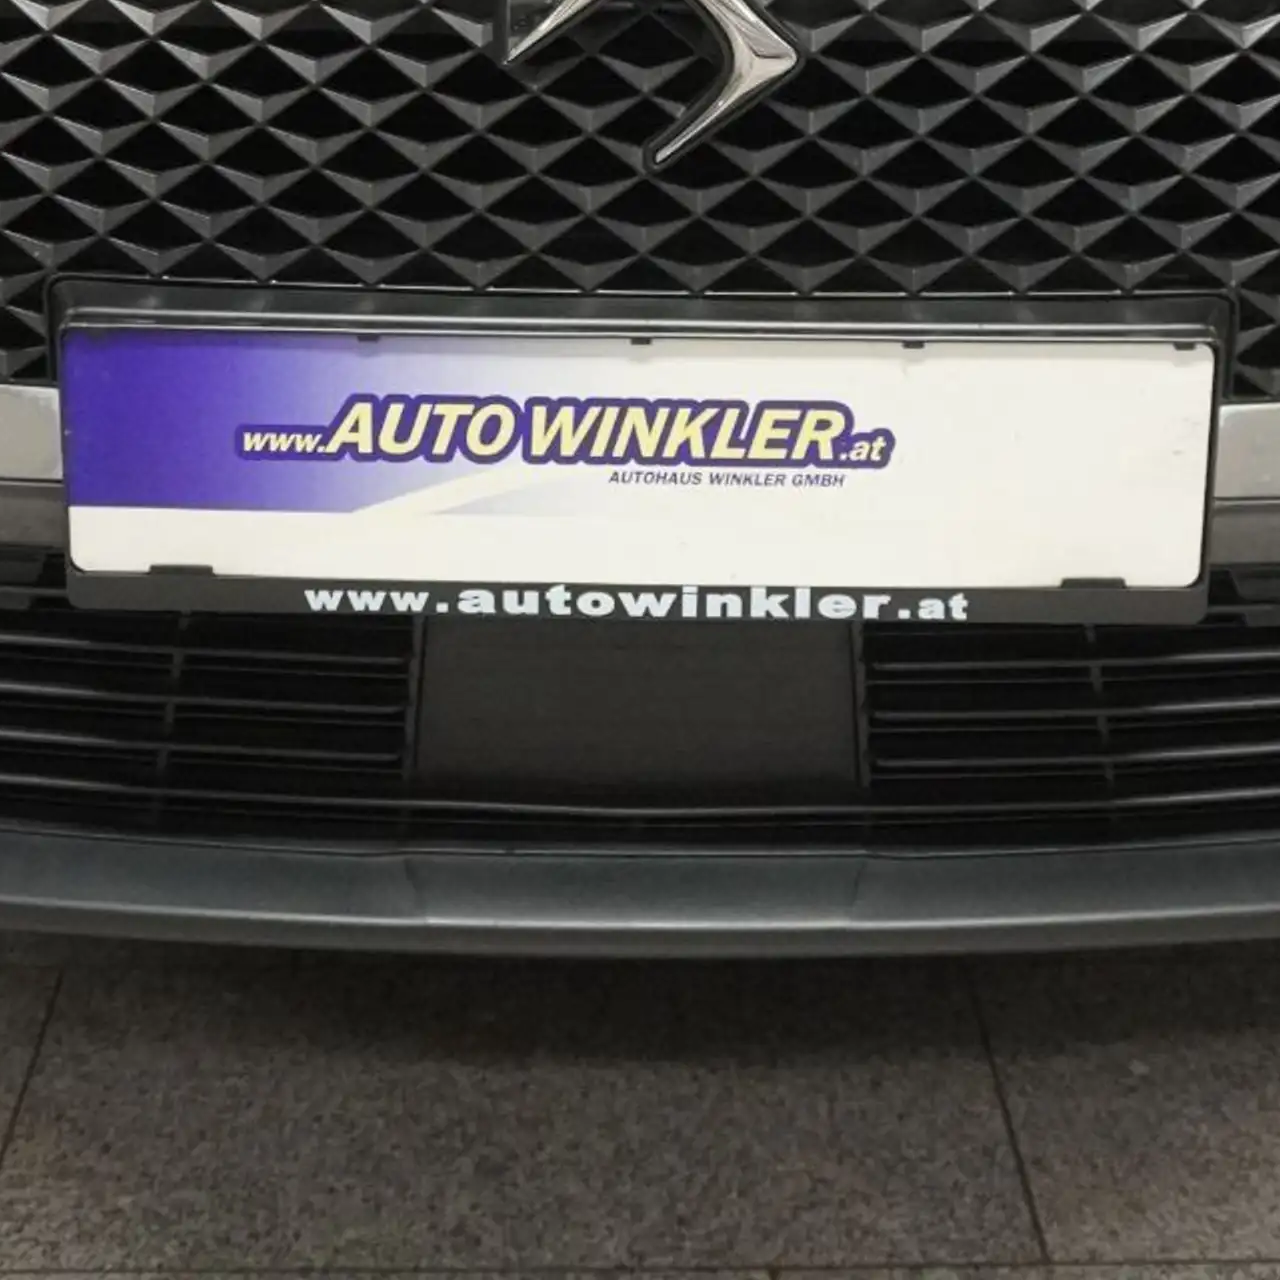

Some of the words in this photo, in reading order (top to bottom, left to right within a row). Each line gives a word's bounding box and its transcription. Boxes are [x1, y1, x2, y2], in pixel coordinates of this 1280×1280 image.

[608, 471, 702, 486] AUTOHAUS
[709, 472, 786, 487] WINKLER
[792, 474, 846, 488] GMBH
[304, 584, 968, 619] www.autowinkler.at
